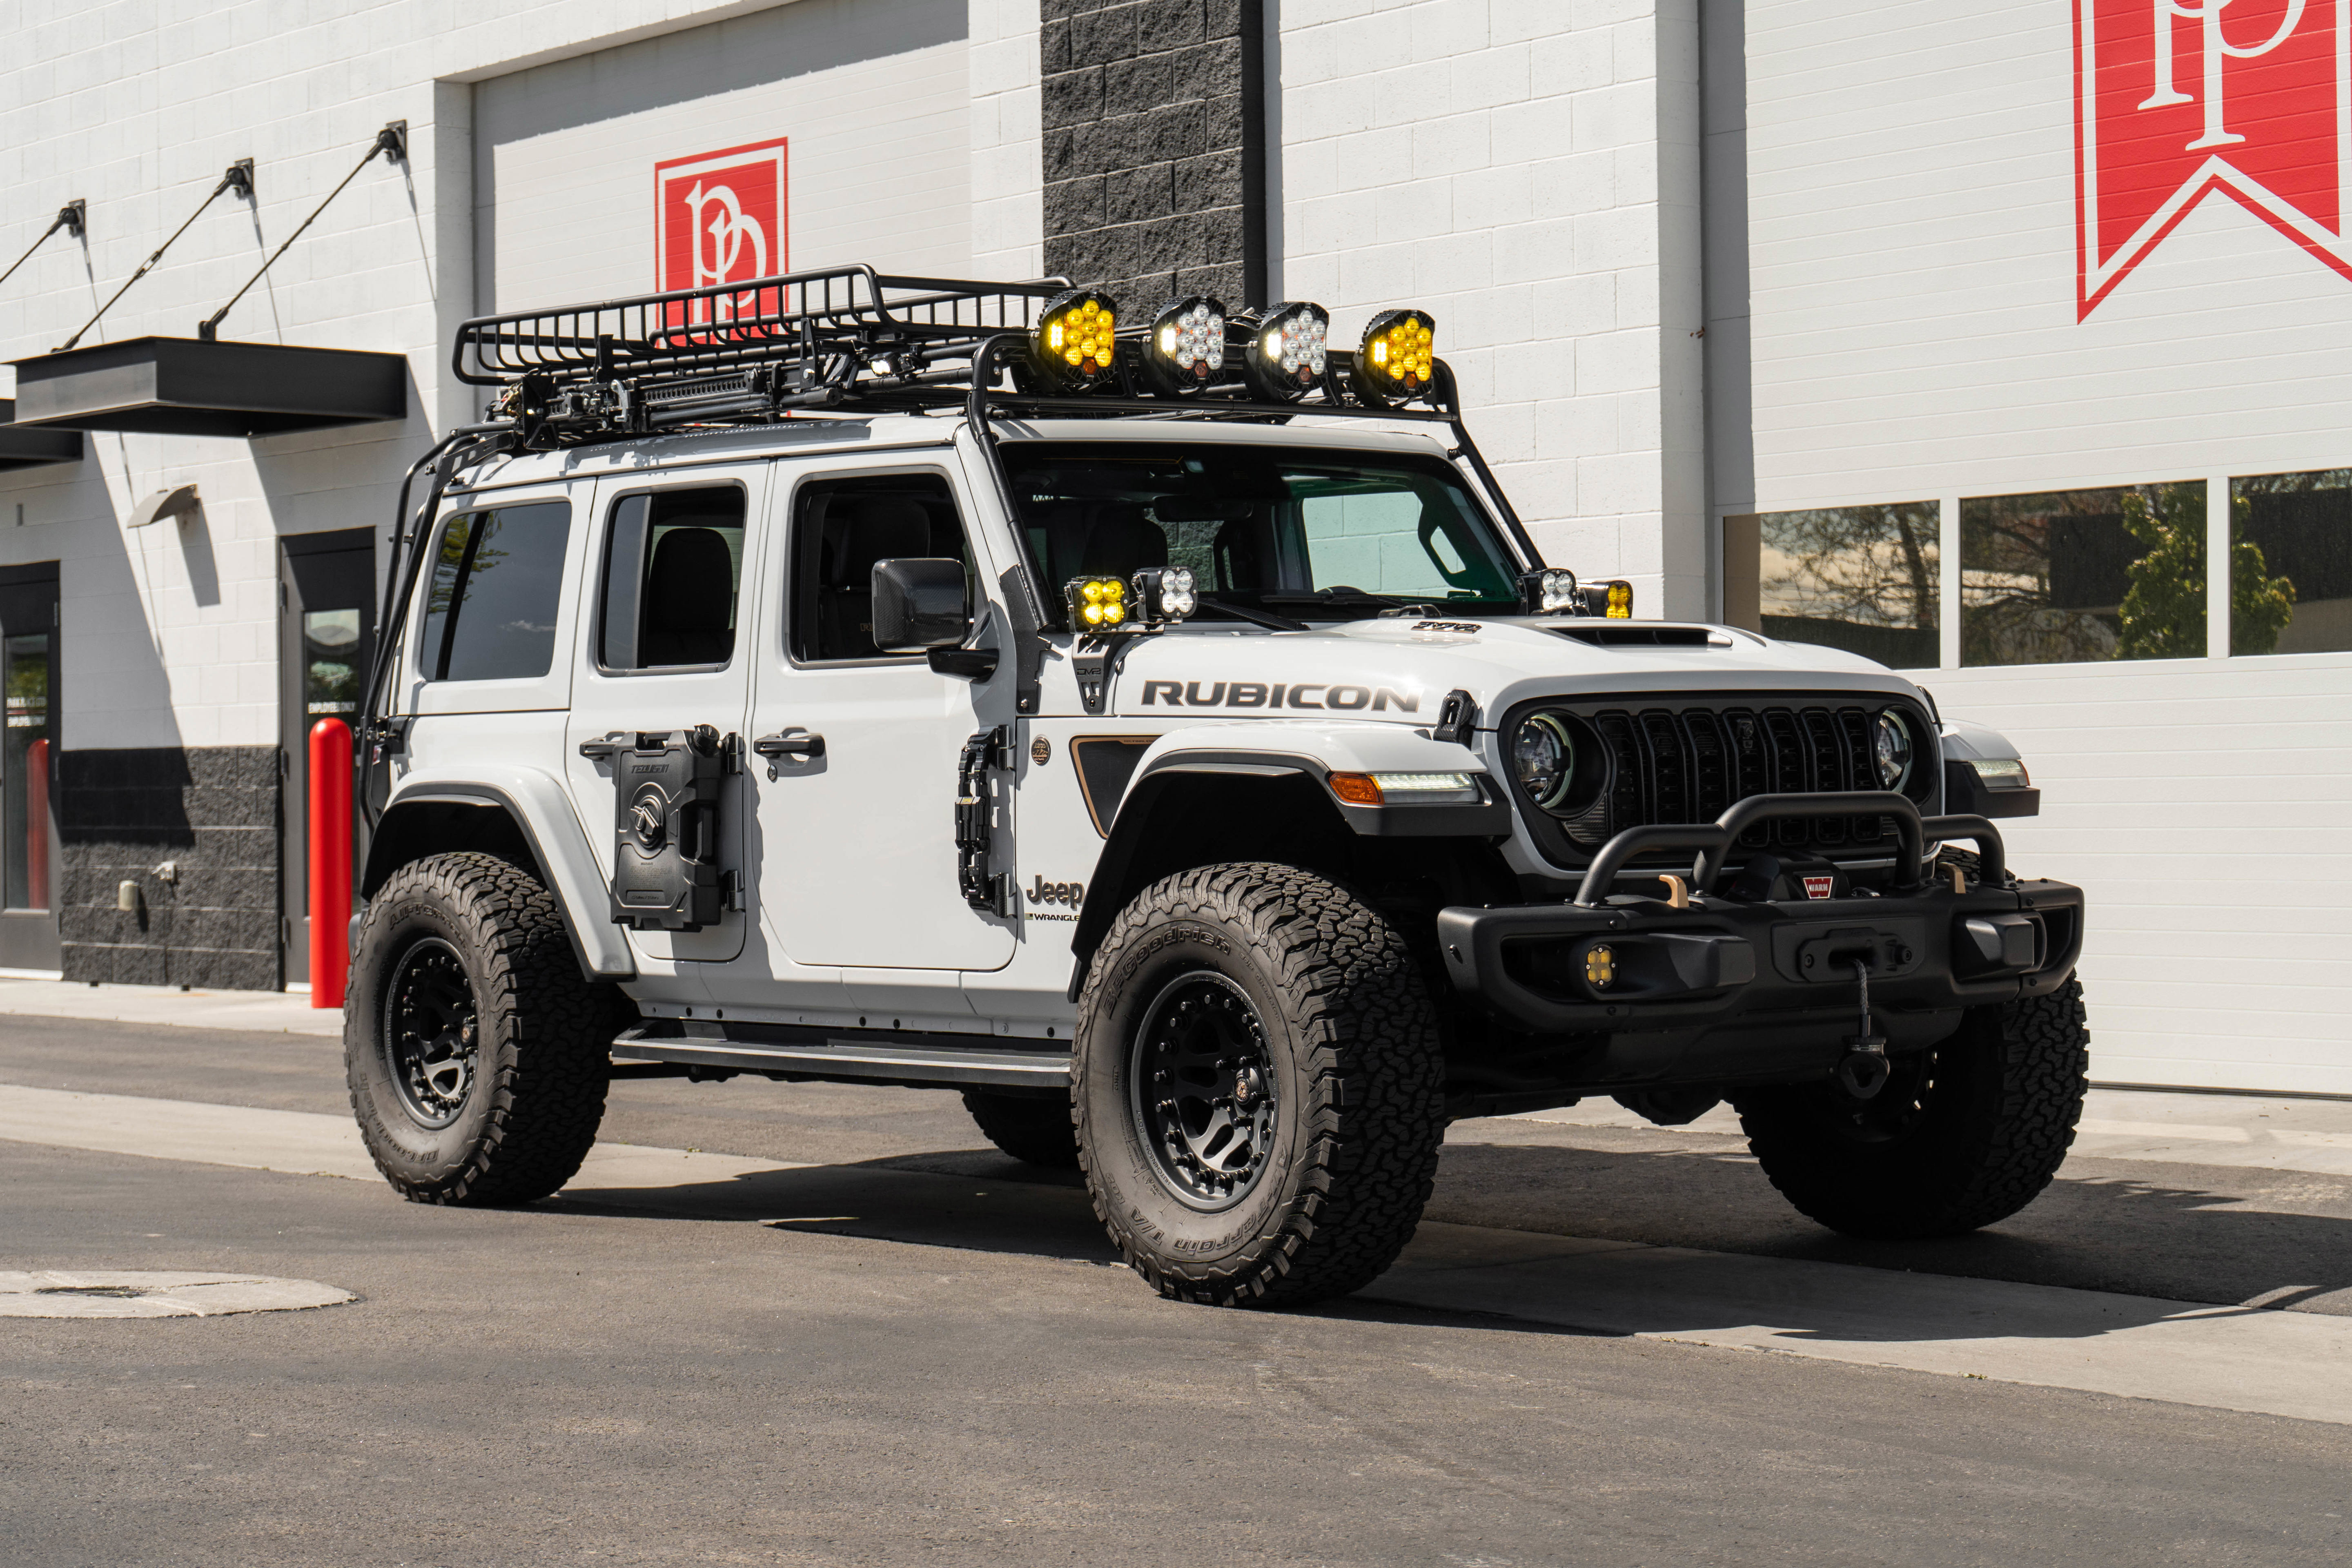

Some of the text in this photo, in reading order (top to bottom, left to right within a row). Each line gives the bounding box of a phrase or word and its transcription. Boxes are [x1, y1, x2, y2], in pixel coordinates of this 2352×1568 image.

[1141, 680, 1425, 713] RUBICON
[1026, 874, 1085, 909] Jeep
[1102, 925, 1231, 1020] BFGoodrich
[1136, 1110, 1171, 1185] HUTCHINSON DOT-T
